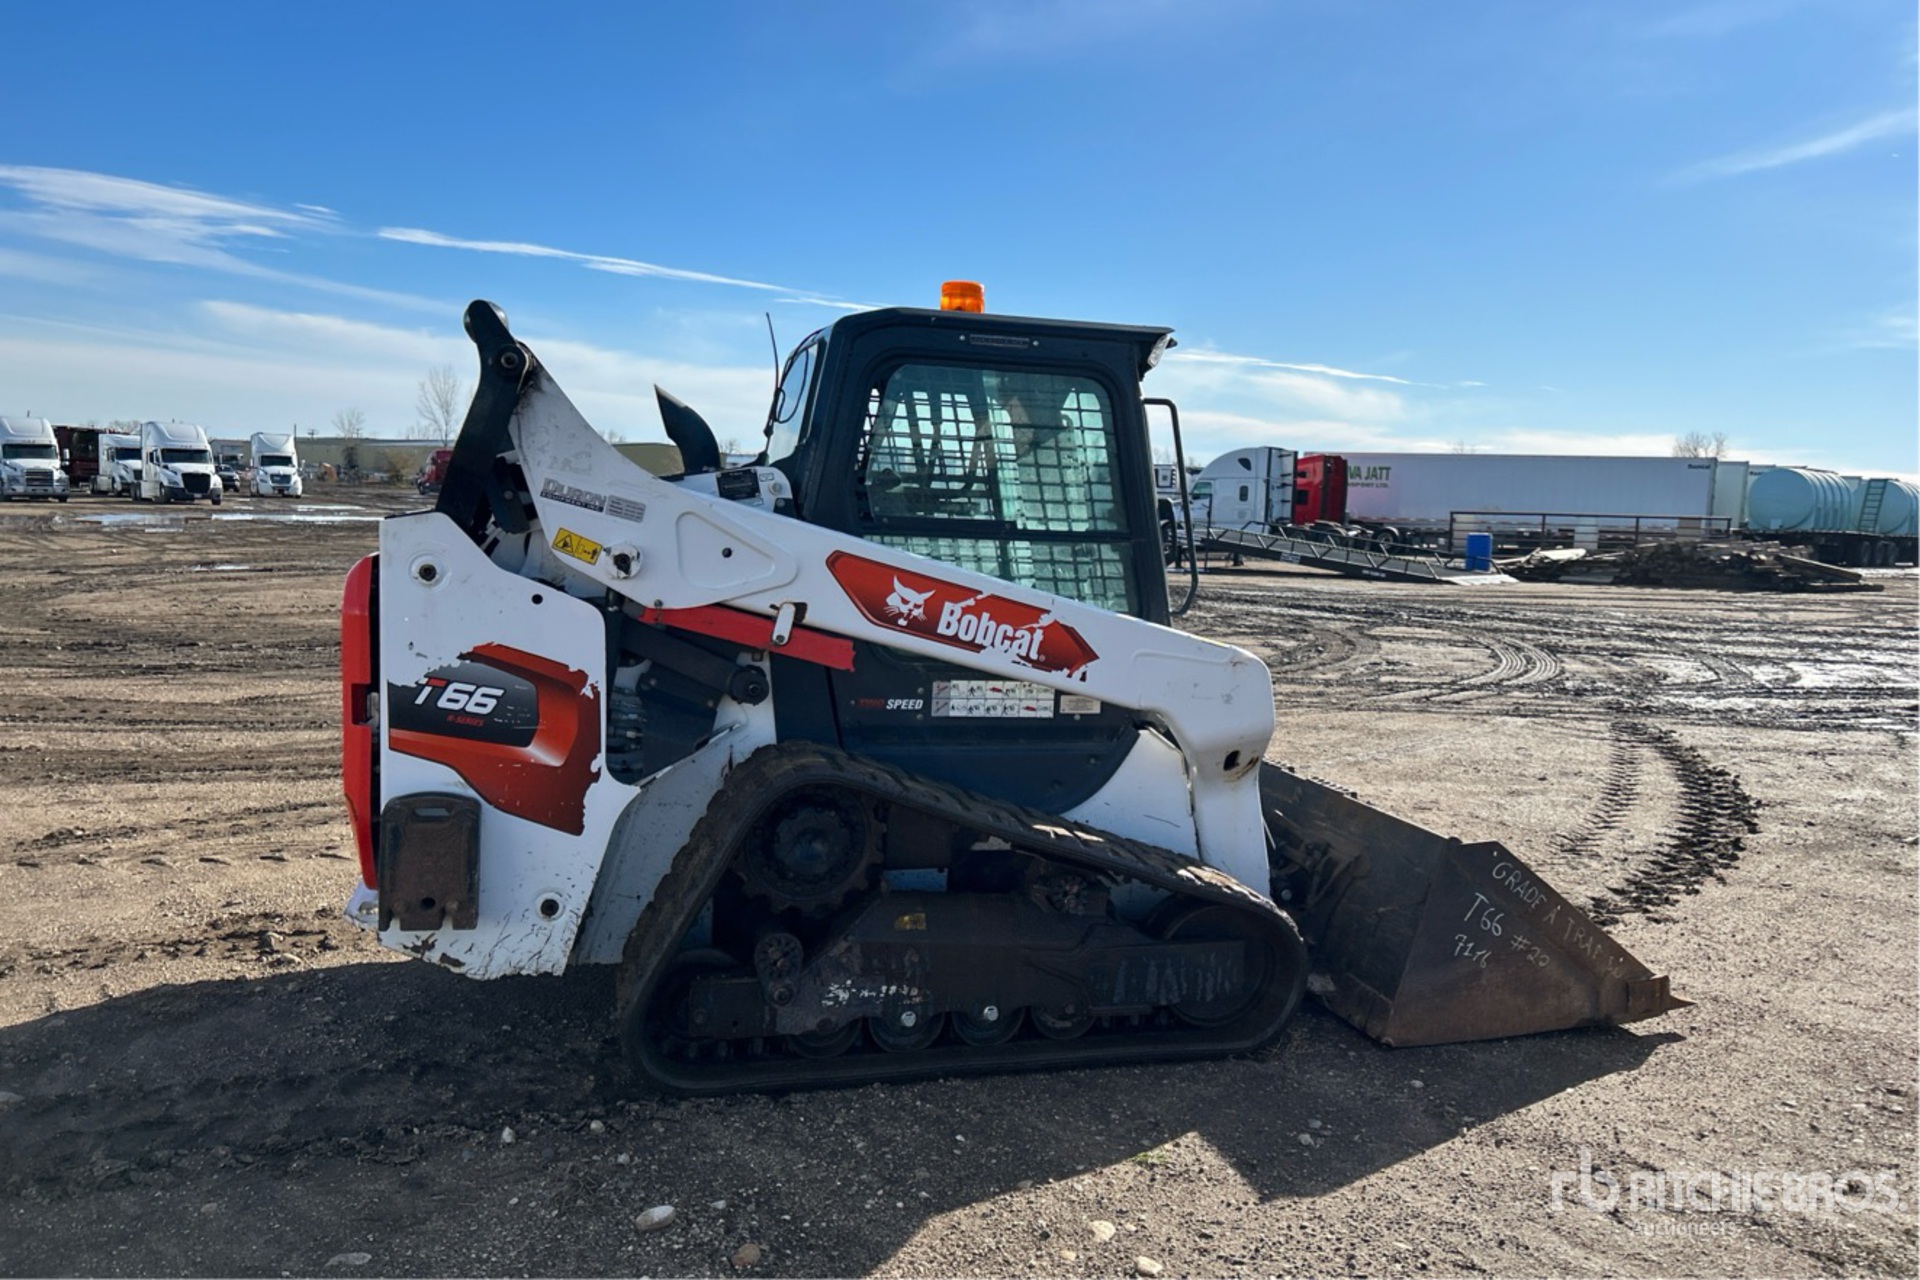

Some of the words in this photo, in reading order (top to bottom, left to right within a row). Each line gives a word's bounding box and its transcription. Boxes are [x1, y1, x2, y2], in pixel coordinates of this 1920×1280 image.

[1365, 466, 1392, 480] JATT
[542, 477, 607, 507] DURON
[937, 601, 1044, 661] Bobcat
[413, 677, 505, 715] T66
[886, 698, 924, 710] SPEED
[1492, 861, 1547, 910] GRADE
